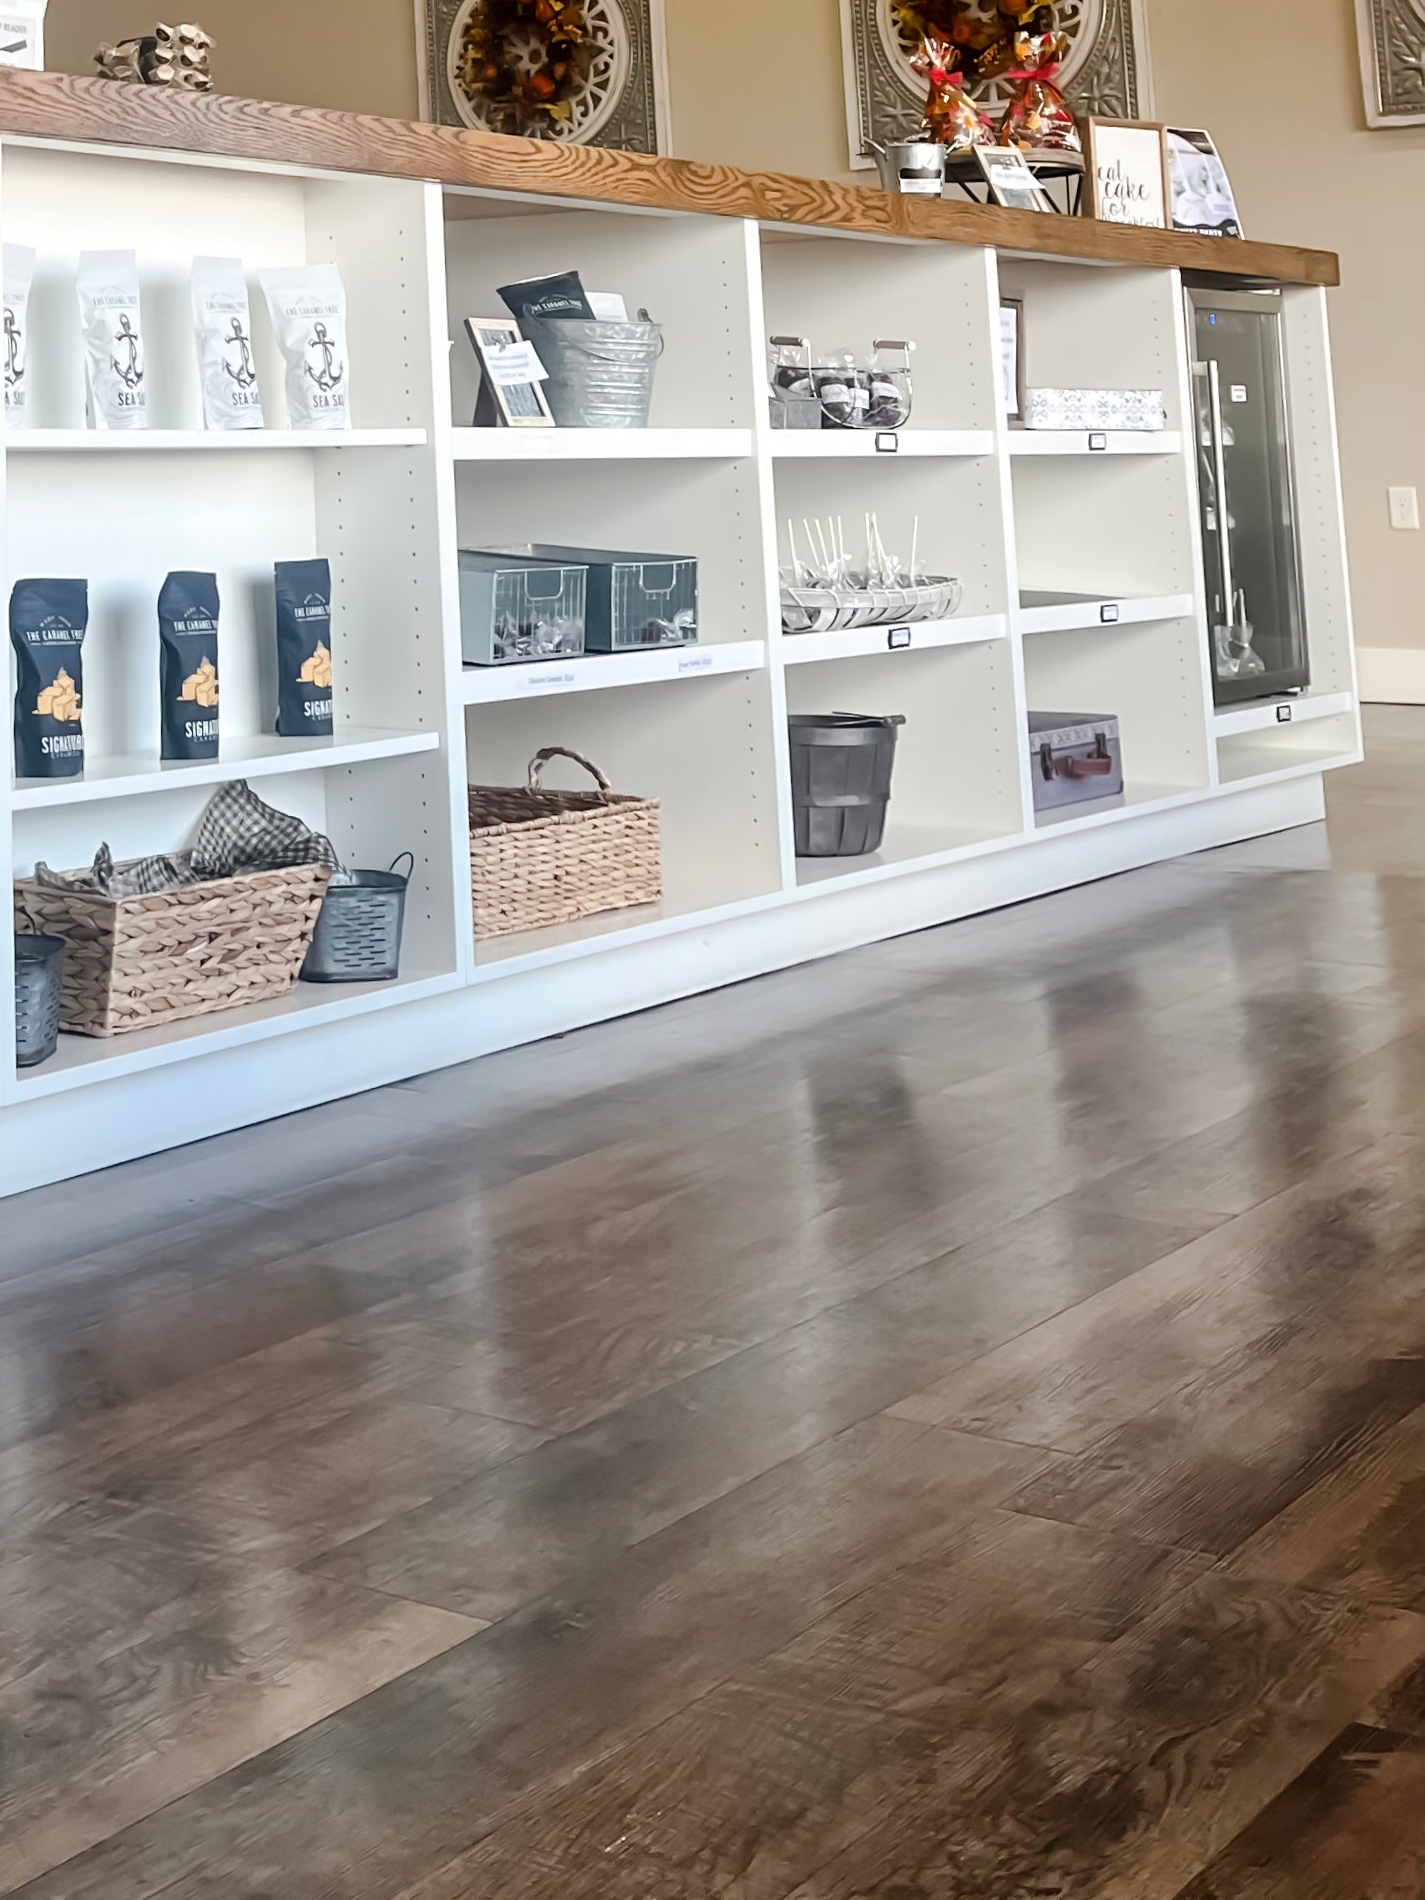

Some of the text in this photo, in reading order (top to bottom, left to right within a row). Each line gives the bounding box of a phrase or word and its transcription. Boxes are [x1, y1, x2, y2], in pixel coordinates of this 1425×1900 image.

[3, 22, 28, 34] READER
[1097, 159, 1125, 182] eat
[1104, 176, 1151, 202] cake
[118, 392, 135, 406] SEA
[232, 393, 249, 406] SEA
[313, 395, 330, 408] SEA
[174, 621, 186, 631] THE
[26, 631, 41, 642] THE
[42, 629, 71, 642] CARAMEL
